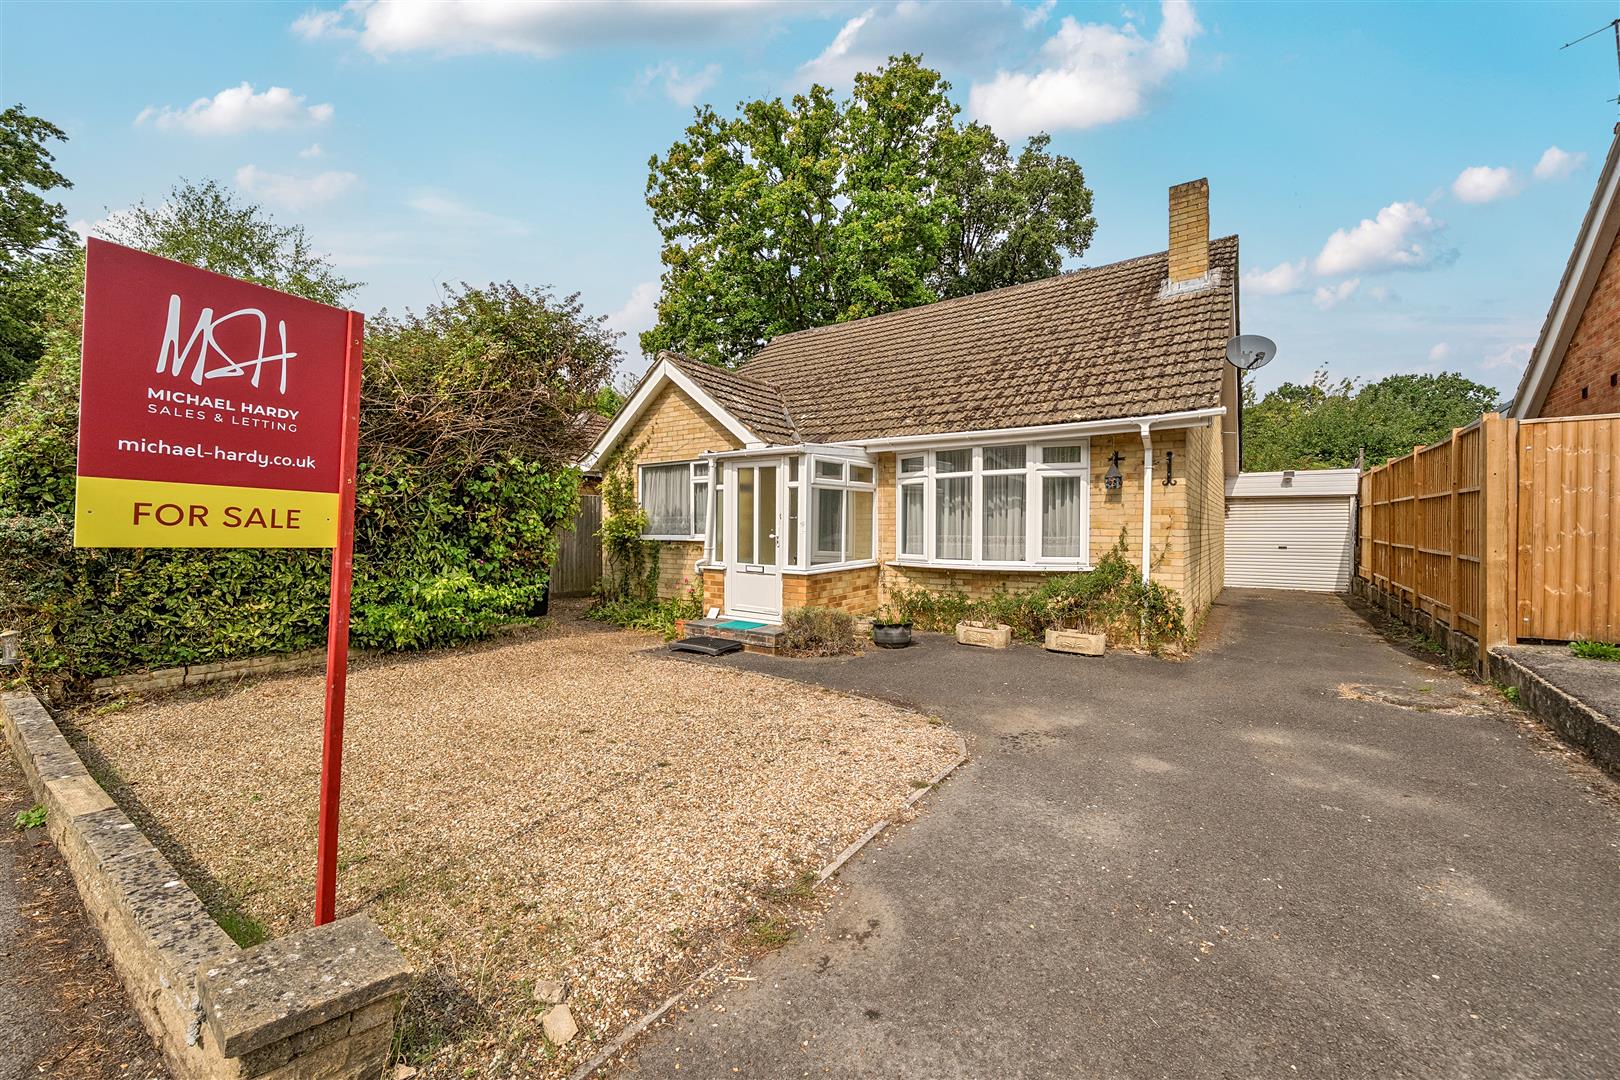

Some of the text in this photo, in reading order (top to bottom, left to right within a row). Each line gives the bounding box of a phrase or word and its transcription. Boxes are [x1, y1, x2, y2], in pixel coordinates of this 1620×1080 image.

[147, 387, 300, 420] MICHAEL HARDY
[147, 404, 298, 433] SALES & LETTING
[117, 438, 316, 470] michael-hardy.co.uk
[132, 502, 301, 530] FOR SALE
